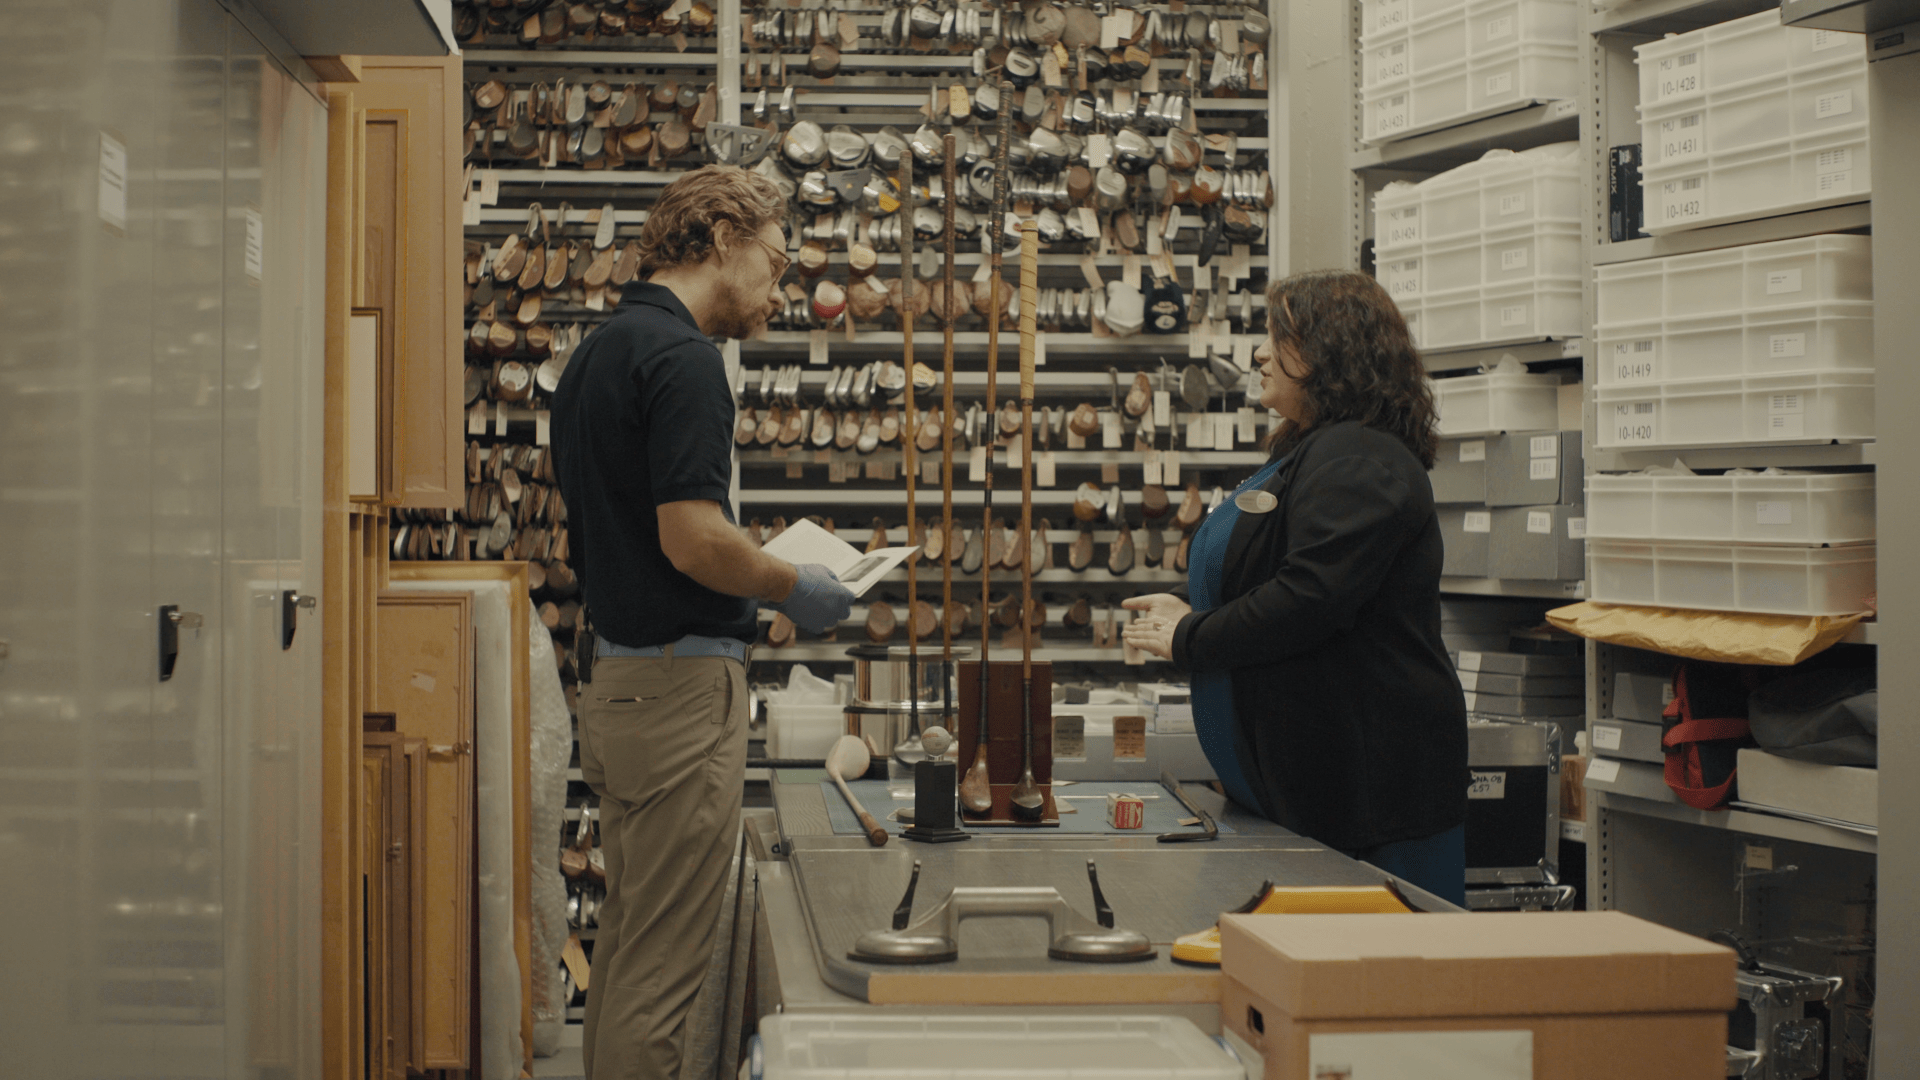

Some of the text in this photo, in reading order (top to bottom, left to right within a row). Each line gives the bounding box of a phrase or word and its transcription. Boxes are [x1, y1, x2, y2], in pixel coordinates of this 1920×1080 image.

[1660, 58, 1672, 71] MU
[1662, 76, 1696, 96] 10-1428
[1662, 120, 1675, 133] MU
[1664, 138, 1697, 157] 10-1431
[1664, 181, 1676, 194] MU
[1666, 201, 1700, 219] 10-1432
[1616, 343, 1628, 355] MU
[1618, 363, 1651, 379] 10-1419
[1616, 404, 1629, 416] MU
[1618, 425, 1652, 440] 10-1420
